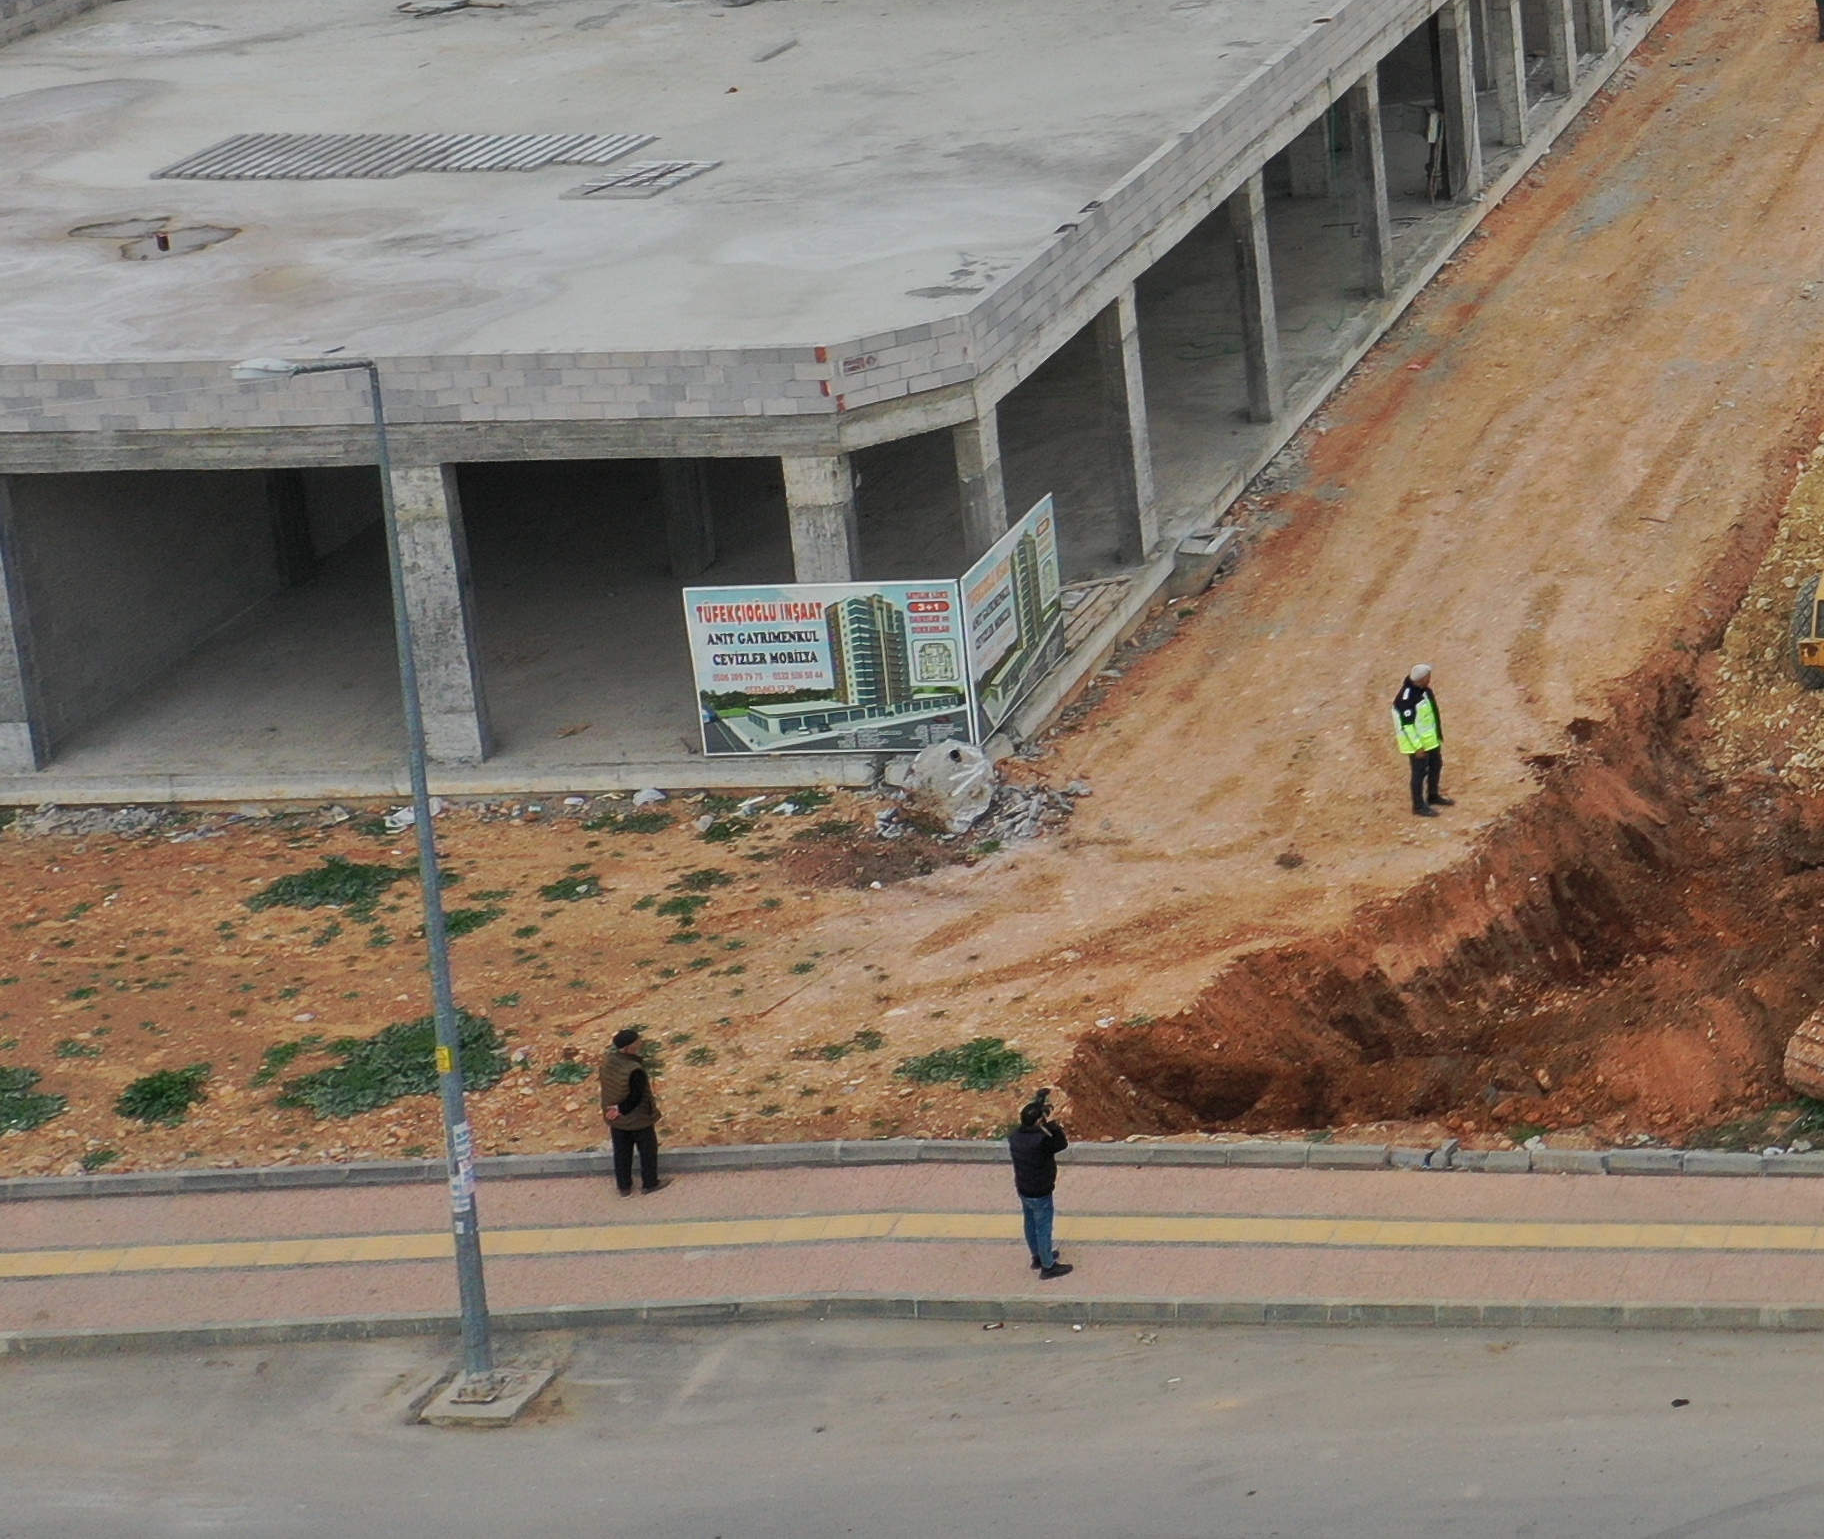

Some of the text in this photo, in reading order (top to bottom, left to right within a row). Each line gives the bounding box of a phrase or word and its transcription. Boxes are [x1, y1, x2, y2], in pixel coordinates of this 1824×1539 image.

[917, 602, 940, 611] 3+1
[707, 629, 820, 646] ANIT GAYRİMENKUL
[713, 649, 819, 666] CEVİZLER MOBİLYA
